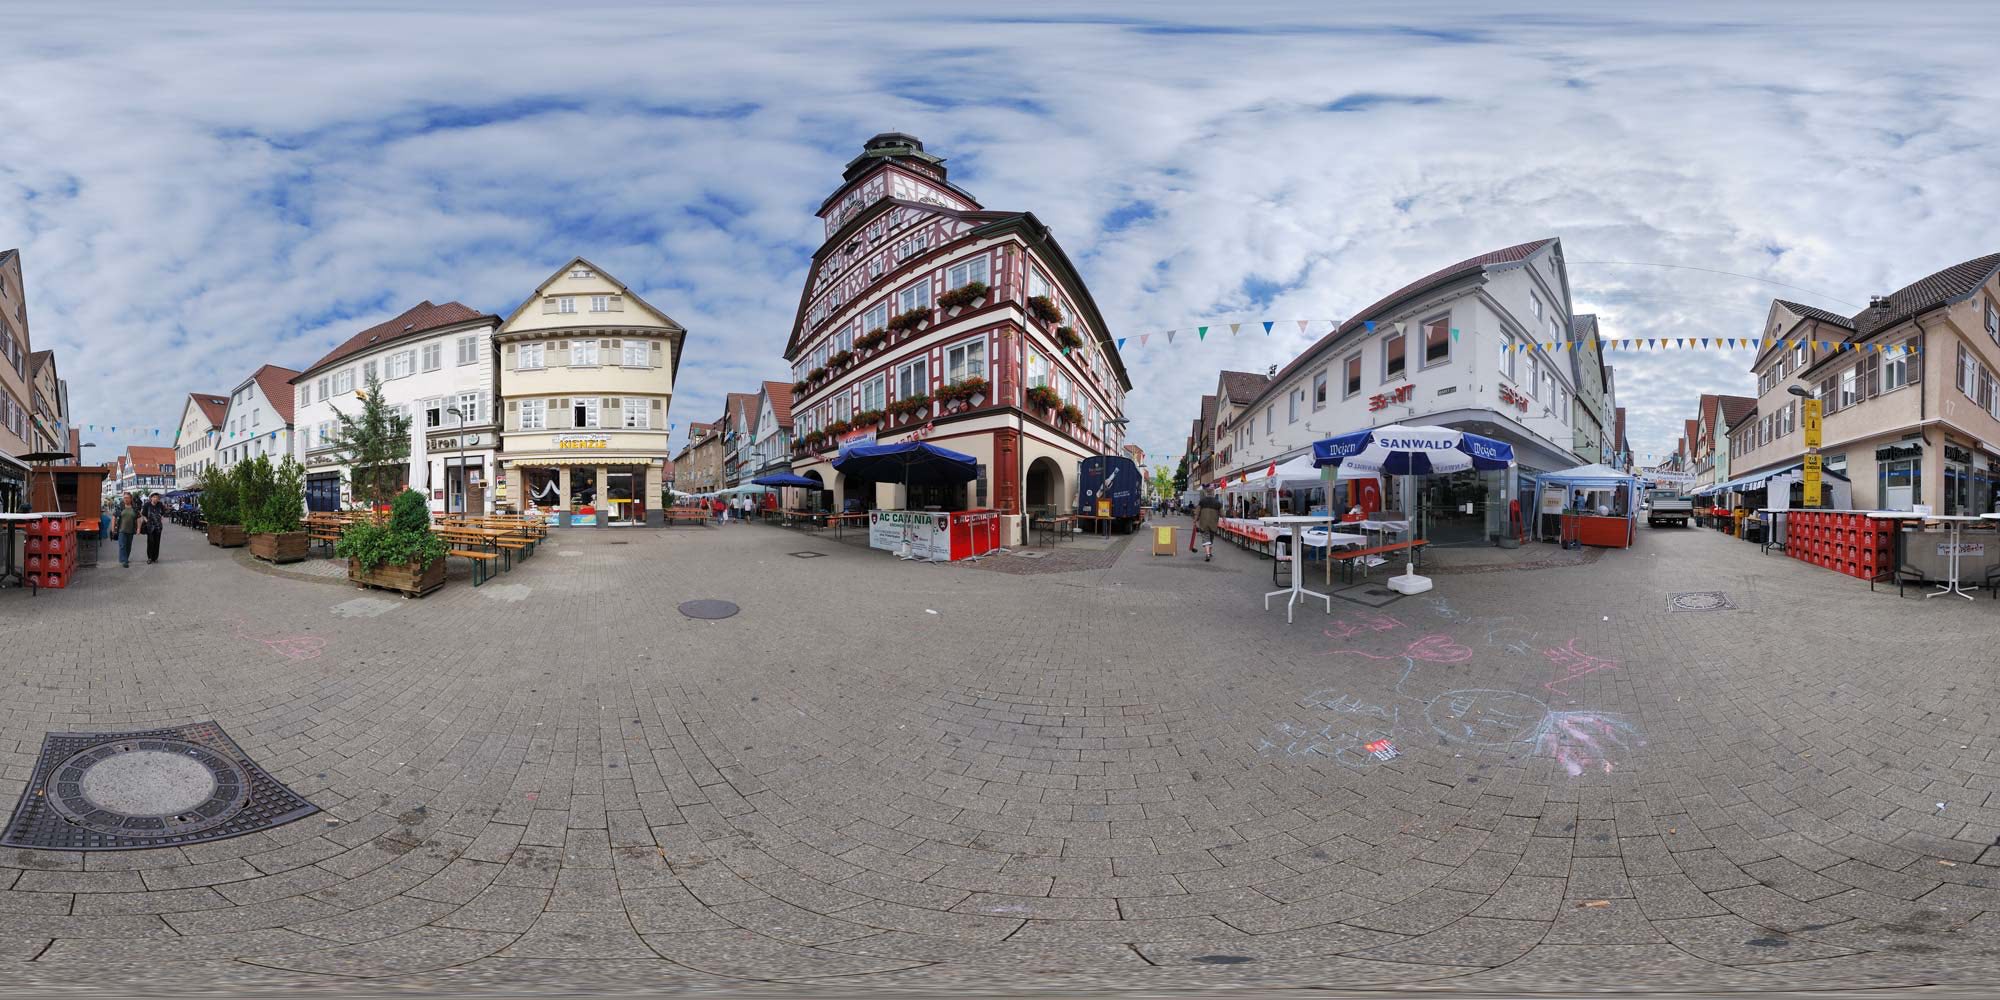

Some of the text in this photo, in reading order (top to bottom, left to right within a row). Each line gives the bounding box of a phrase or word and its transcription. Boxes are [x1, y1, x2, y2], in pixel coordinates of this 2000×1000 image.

[1946, 399, 1956, 416] 17
[560, 439, 607, 449] KIENZLE
[1329, 442, 1357, 456] Weizen
[1380, 438, 1453, 450] SANWALD
[879, 513, 932, 525] AC CATANIA
